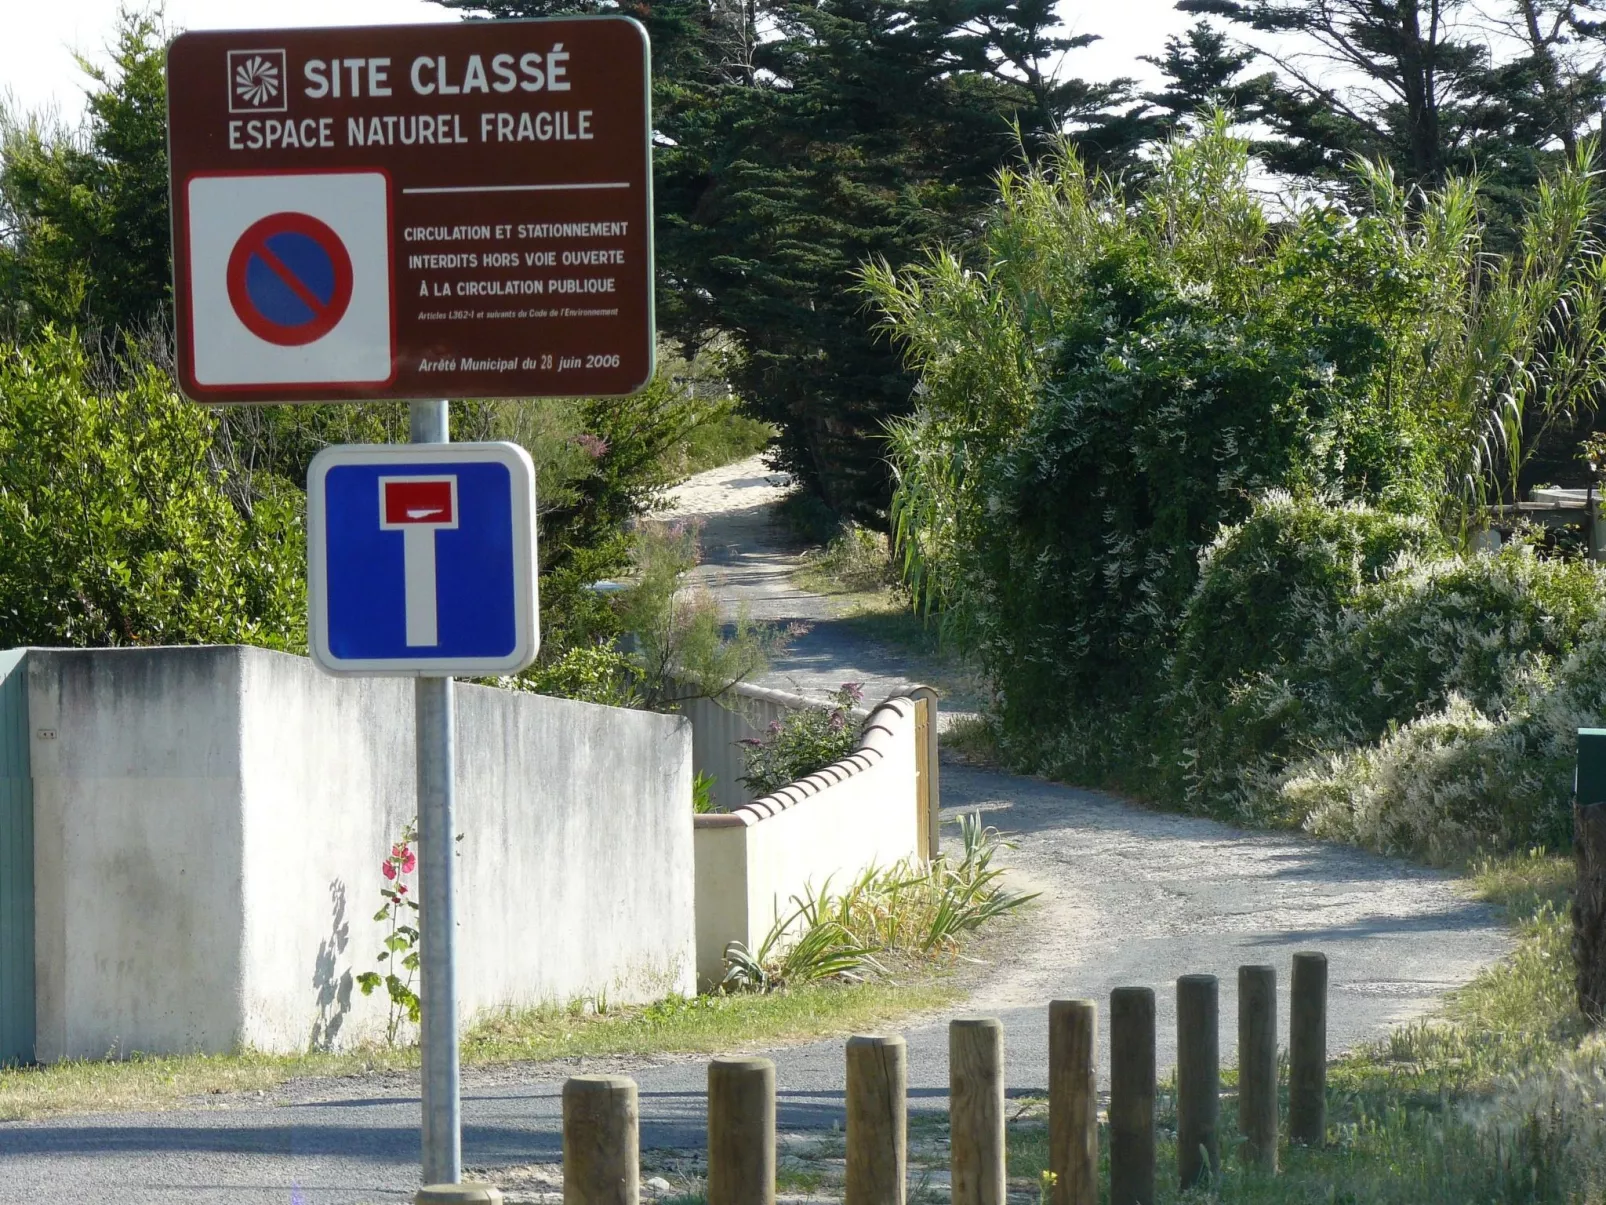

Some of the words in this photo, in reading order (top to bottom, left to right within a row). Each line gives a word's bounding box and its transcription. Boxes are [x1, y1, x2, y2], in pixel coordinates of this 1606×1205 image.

[303, 57, 393, 99] SITE
[410, 43, 571, 95] CLASSÉ
[228, 118, 335, 150] ESPACE
[347, 114, 468, 146] NATUREL
[480, 110, 594, 142] FRAGILE
[404, 225, 490, 241] CIRCULATION
[495, 225, 512, 239] ET
[518, 222, 628, 238] STATIONNEMENT
[409, 253, 478, 269] INTERDITS
[483, 252, 519, 267] HORS
[525, 252, 556, 266] VOIE
[562, 250, 625, 265] OUVERTE
[419, 280, 429, 297] À
[434, 282, 451, 296] LA
[457, 280, 543, 296] CIRCULATION
[548, 278, 616, 293] PUBLIQUE
[418, 311, 446, 320] Articles
[476, 311, 484, 319] et
[486, 310, 515, 319] suivants
[517, 310, 527, 318] du
[529, 309, 547, 318] Code
[549, 308, 559, 317] de
[418, 358, 456, 372] Arrêté
[460, 356, 518, 373] Municipal
[522, 357, 537, 370] du
[540, 354, 553, 370] 28
[557, 355, 582, 372] juin
[585, 355, 620, 368] 2006
